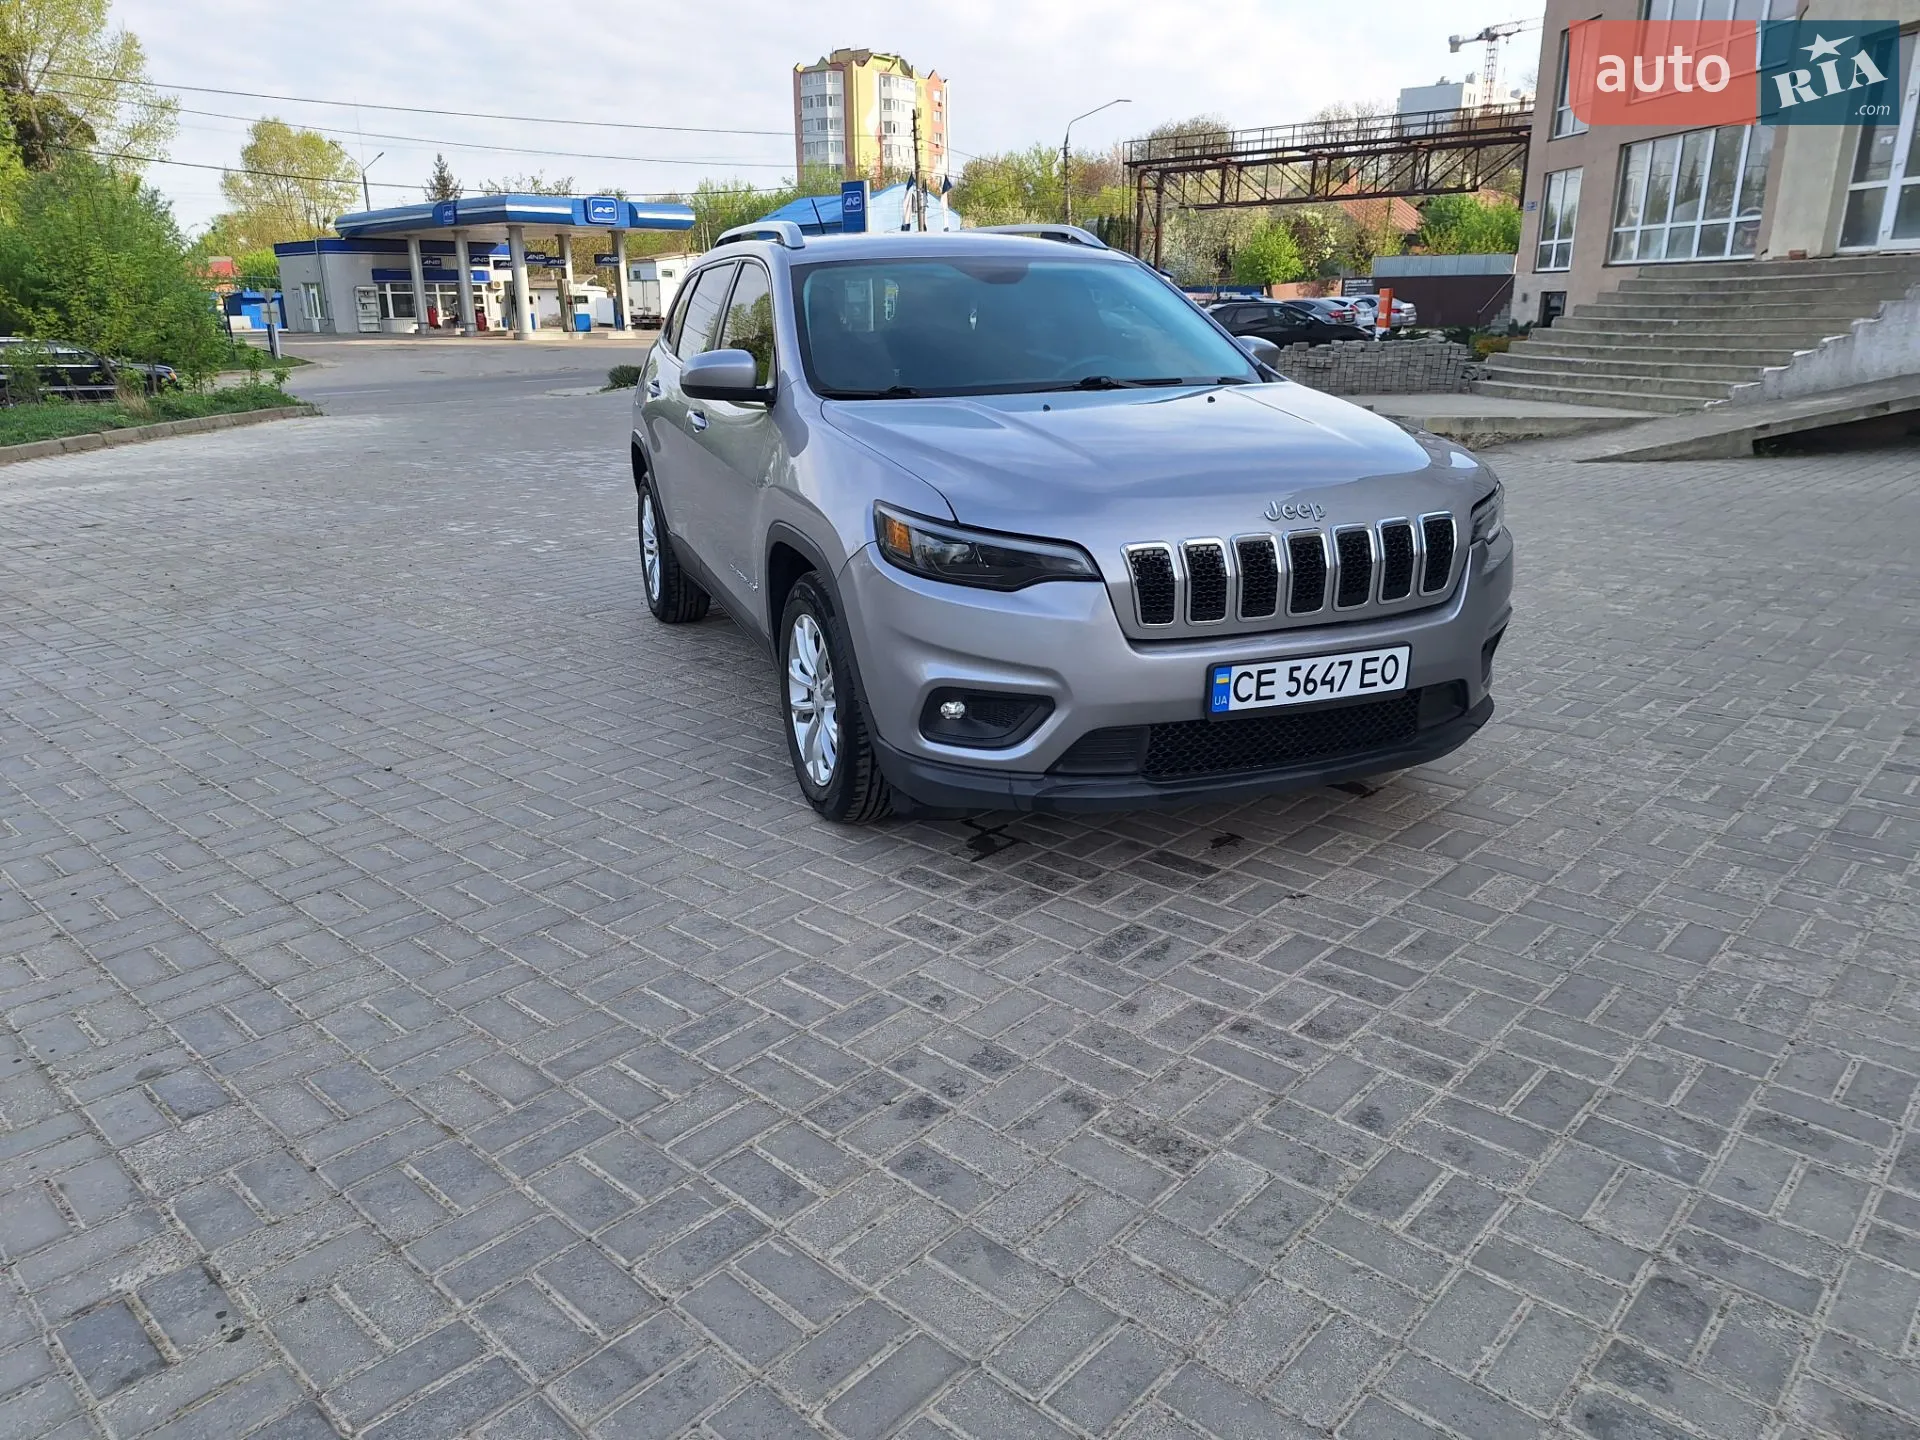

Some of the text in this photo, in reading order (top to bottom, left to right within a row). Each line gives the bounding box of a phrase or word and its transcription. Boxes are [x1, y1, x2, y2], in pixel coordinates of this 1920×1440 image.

[1263, 500, 1327, 522] Jeep
[1232, 654, 1400, 703] CE 5647 EO
[1214, 695, 1228, 706] UA
